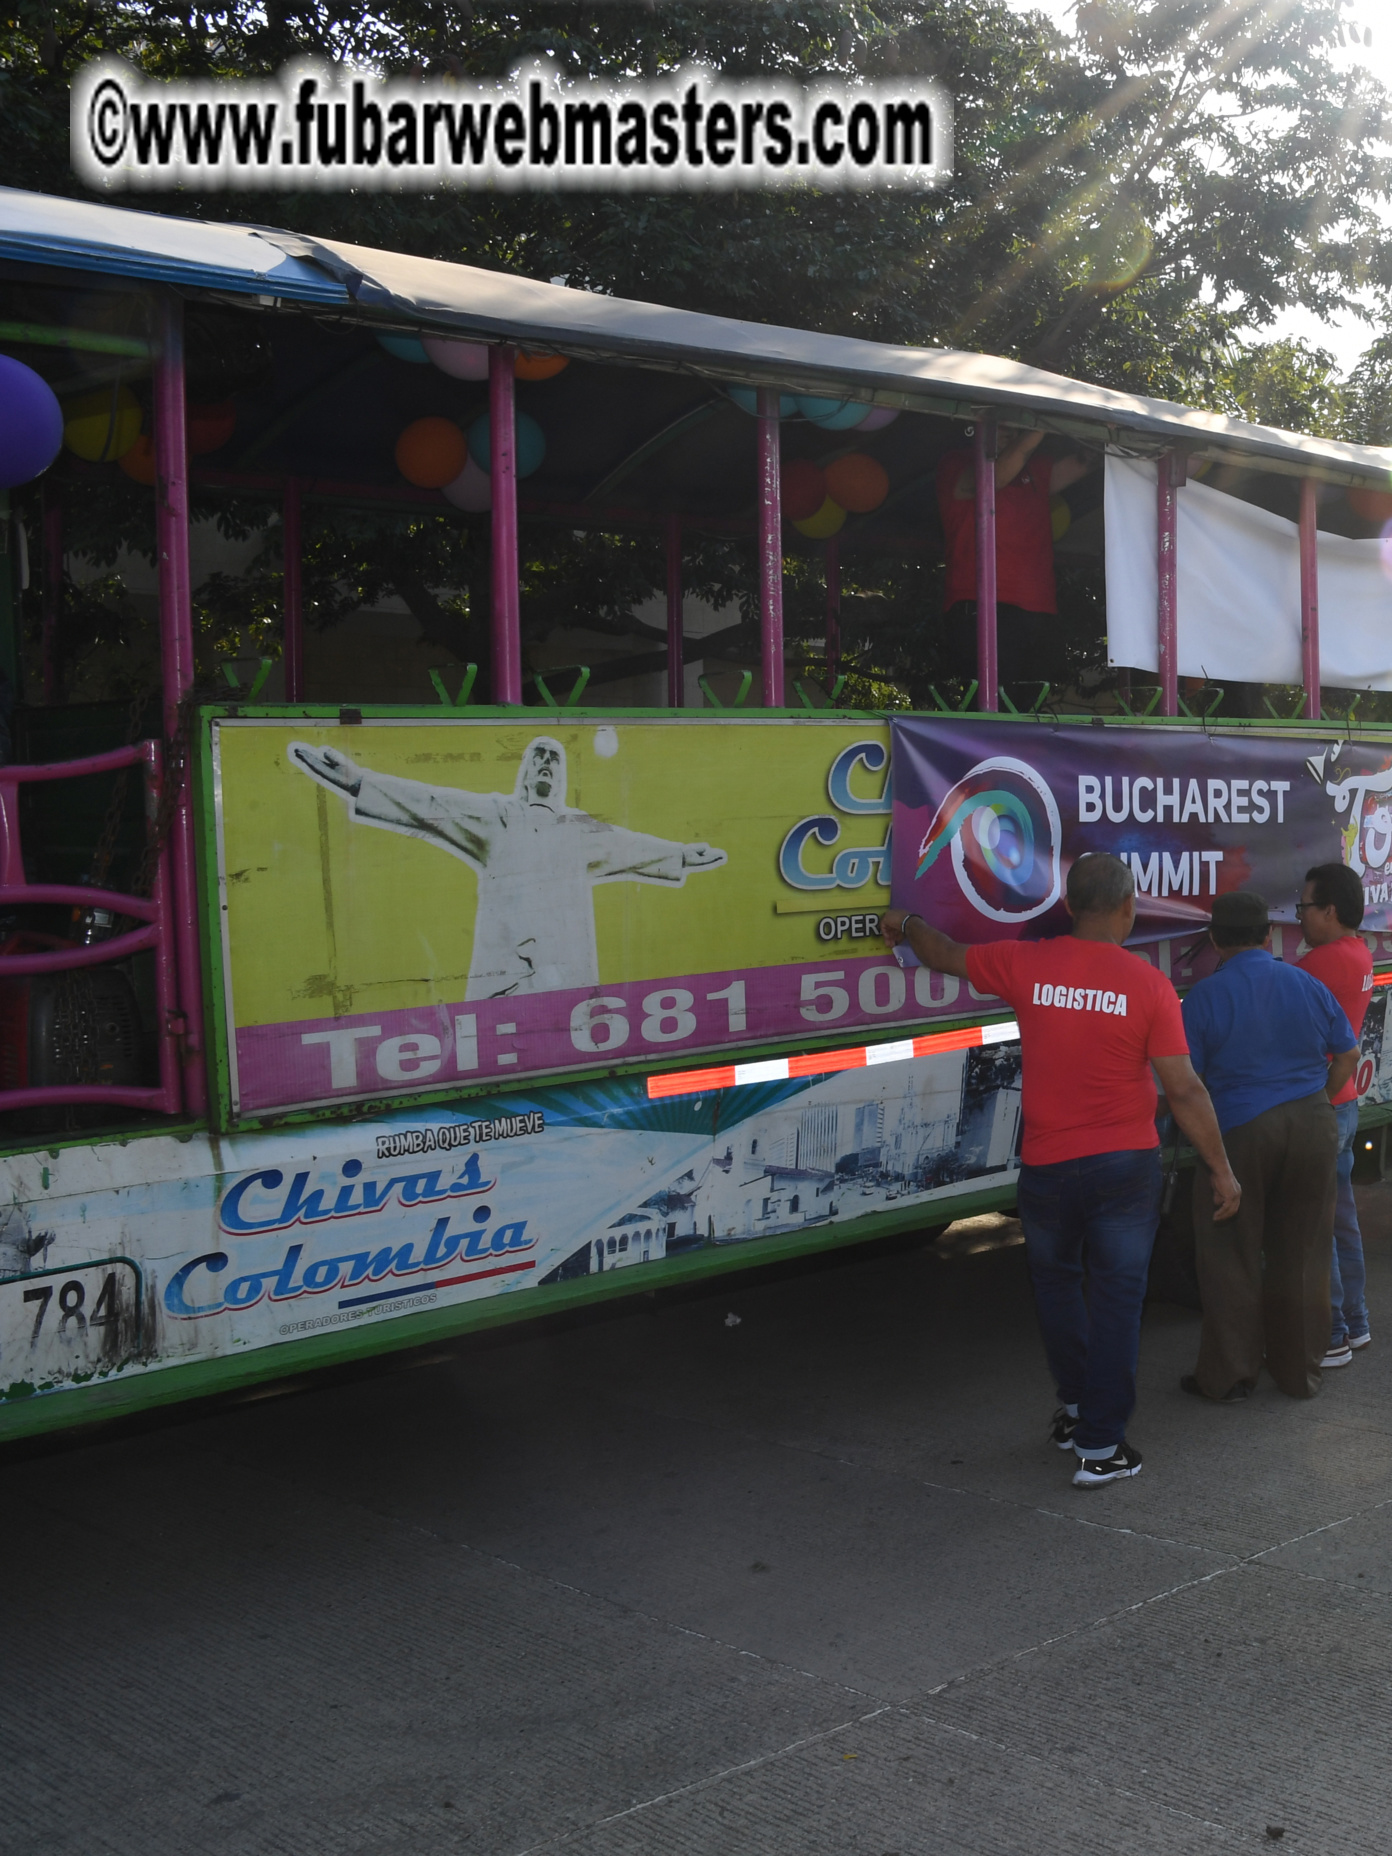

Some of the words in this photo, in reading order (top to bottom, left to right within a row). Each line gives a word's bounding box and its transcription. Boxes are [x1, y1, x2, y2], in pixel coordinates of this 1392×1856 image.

[1078, 775, 1290, 824] BUCHAREST
[1079, 851, 1223, 898] MMIT
[1033, 982, 1128, 1017] LOGISTICA
[301, 1012, 518, 1090] Tel:
[569, 980, 747, 1054] 681
[799, 963, 1002, 1023] 500
[376, 1128, 436, 1160] RUMBA
[438, 1122, 471, 1149] QUE
[473, 1117, 494, 1143] TE
[494, 1111, 545, 1141] MUEVE
[217, 1151, 498, 1237] Chivas
[163, 1205, 540, 1321] Colombia
[23, 1271, 120, 1350] 784
[279, 1309, 365, 1336] OPERADORES
[366, 1292, 437, 1318] TURISTICOS
